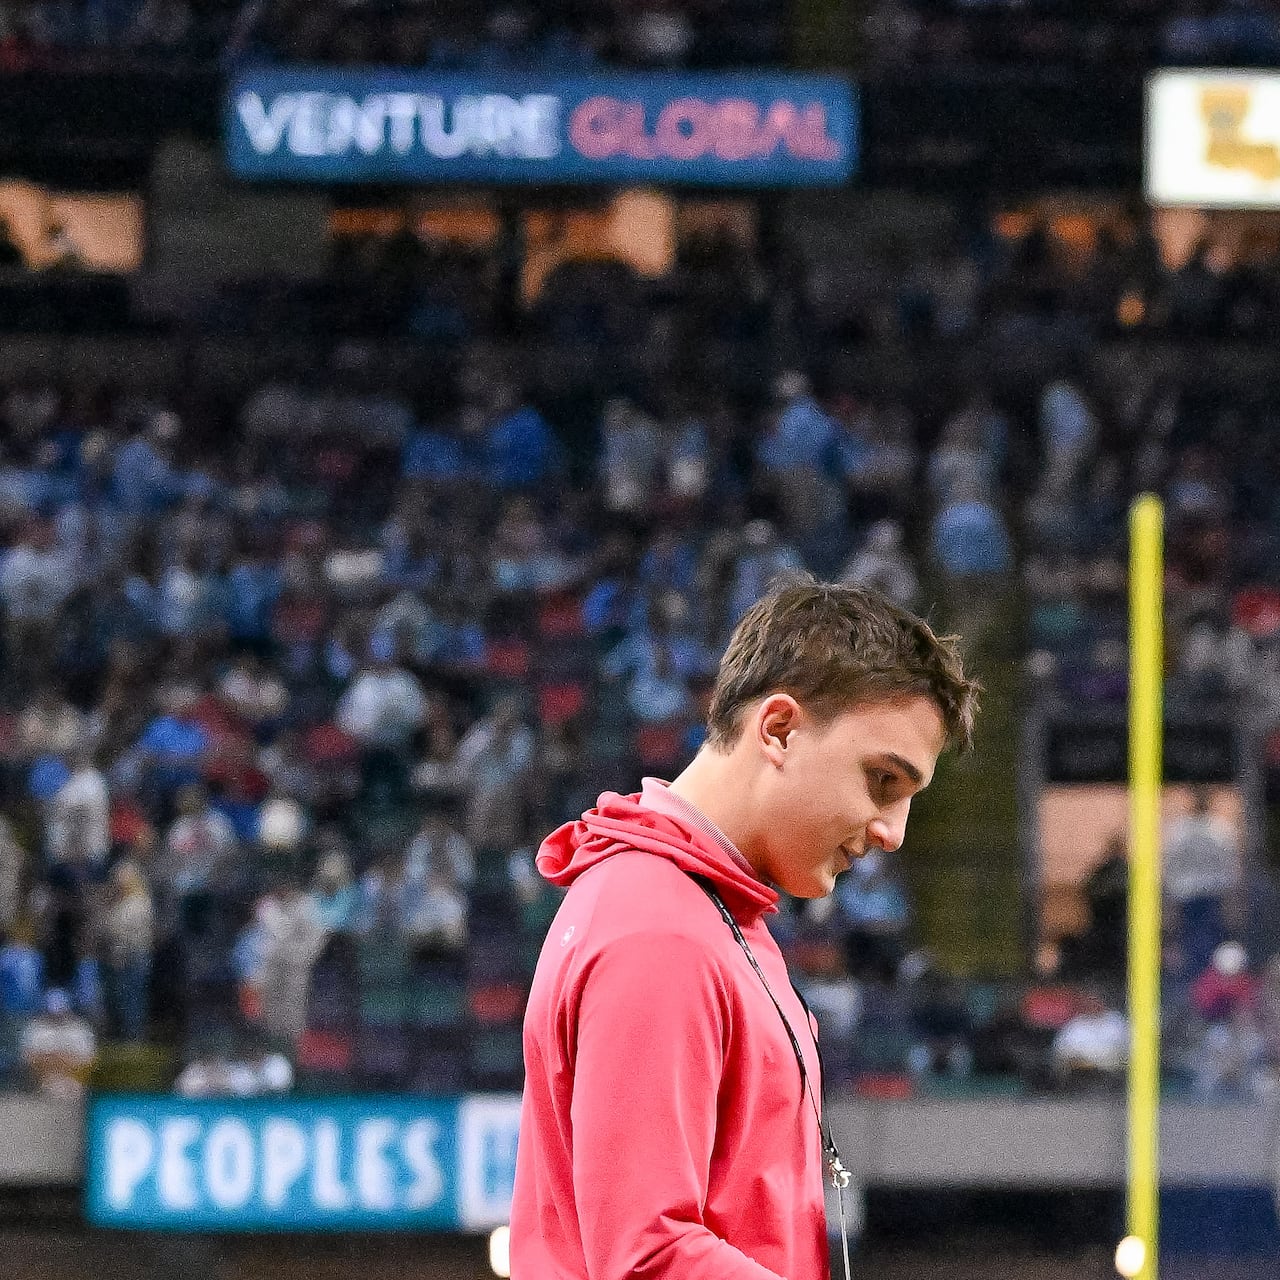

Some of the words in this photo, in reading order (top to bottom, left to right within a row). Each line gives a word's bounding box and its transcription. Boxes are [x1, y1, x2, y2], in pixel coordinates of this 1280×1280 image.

[237, 92, 561, 159] VENTURE
[569, 97, 840, 162] GLOBAL
[105, 1115, 445, 1212] PEOPLES
